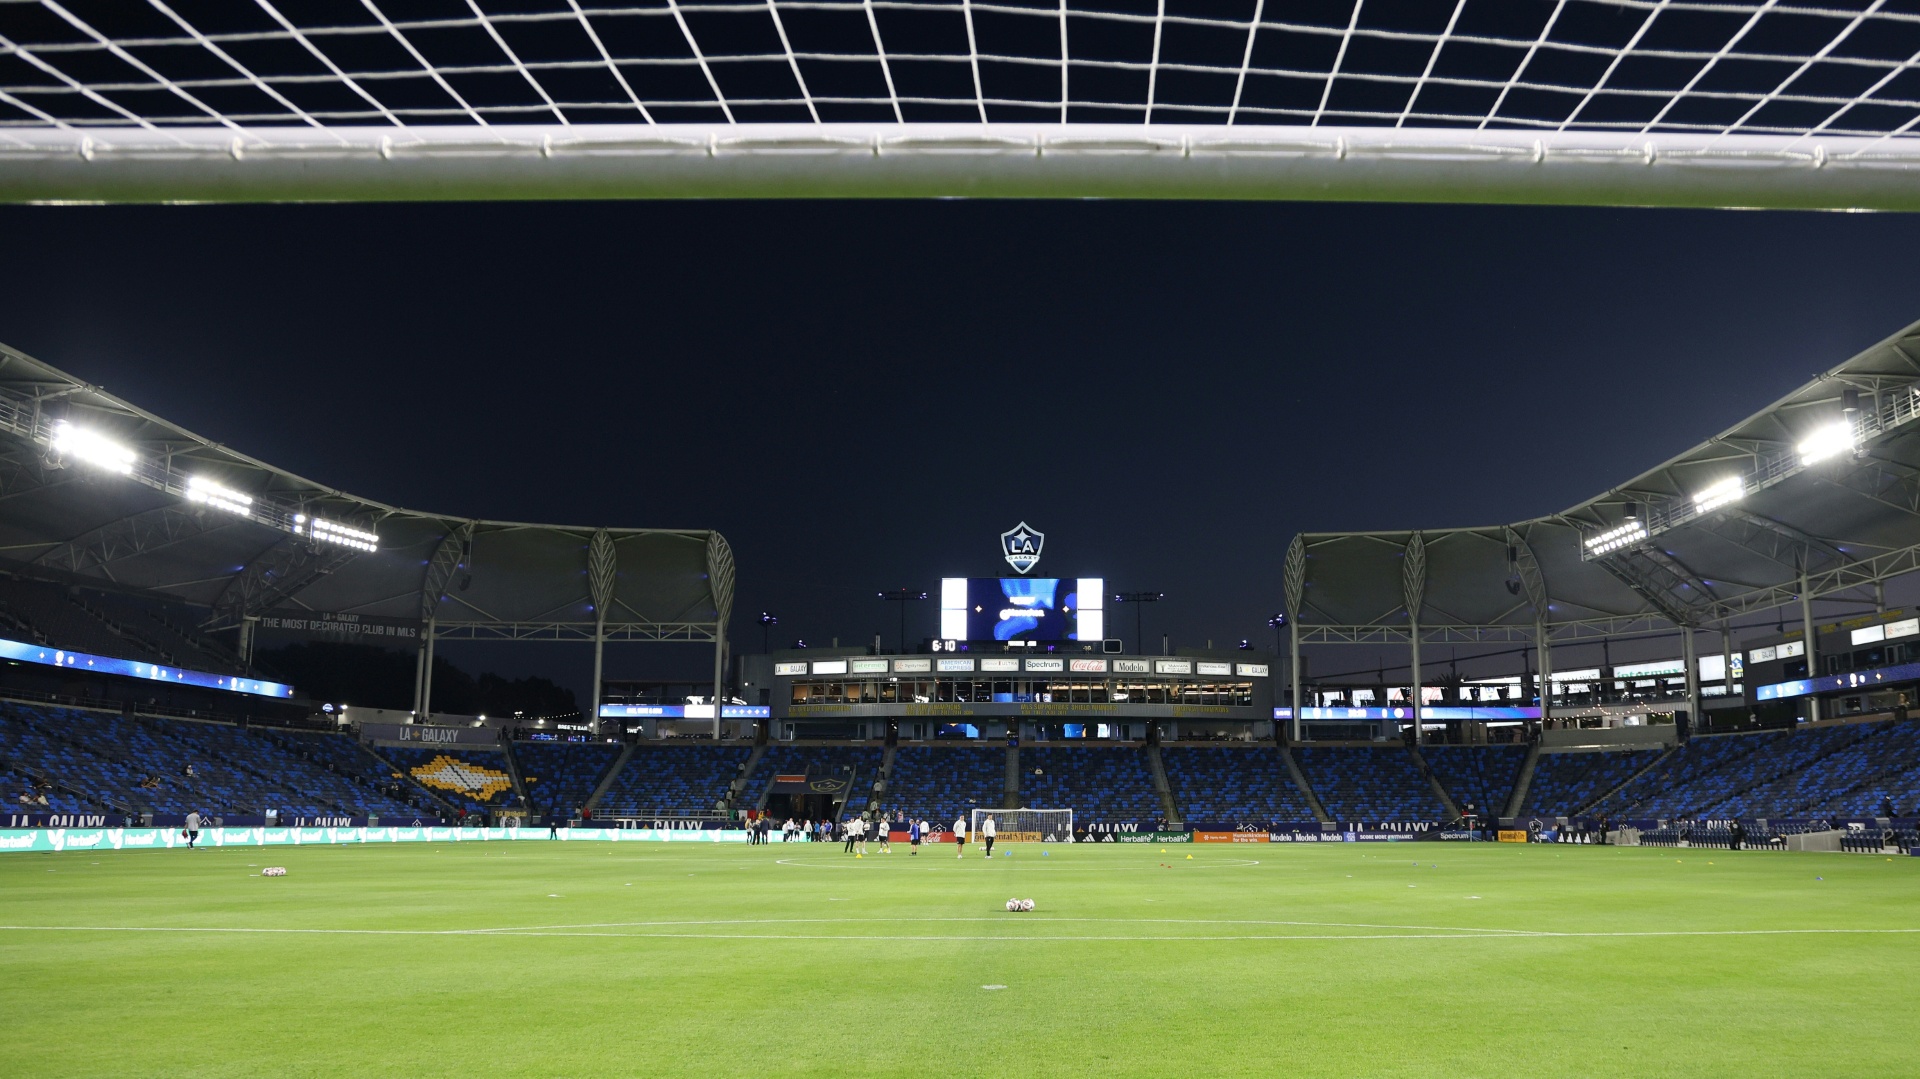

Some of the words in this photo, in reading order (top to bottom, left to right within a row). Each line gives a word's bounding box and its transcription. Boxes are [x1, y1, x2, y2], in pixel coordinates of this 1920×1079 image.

[1012, 540, 1034, 553] LA
[323, 612, 330, 620] LA
[337, 613, 359, 622] GALAXY
[263, 617, 279, 628] THE
[282, 618, 307, 630] MOST
[310, 620, 360, 633] DECORATED
[363, 624, 383, 635] CLUB
[386, 626, 394, 636] IN
[397, 626, 415, 638] MLS
[932, 640, 956, 652] 6:10
[775, 665, 781, 673] LA
[789, 664, 807, 673] GALAXY
[1026, 661, 1061, 669] Spectrum
[1118, 662, 1144, 672] Modelo
[1251, 666, 1268, 674] GALAXY
[400, 727, 410, 741] LA
[421, 728, 459, 743] GALAXY
[1120, 834, 1151, 843] Herbalife
[1156, 834, 1187, 843] Herbalife
[1270, 833, 1292, 842] Modelo
[1295, 833, 1317, 842] Modelo
[1320, 833, 1342, 842] Modelo
[1440, 832, 1469, 840] Spectrum
